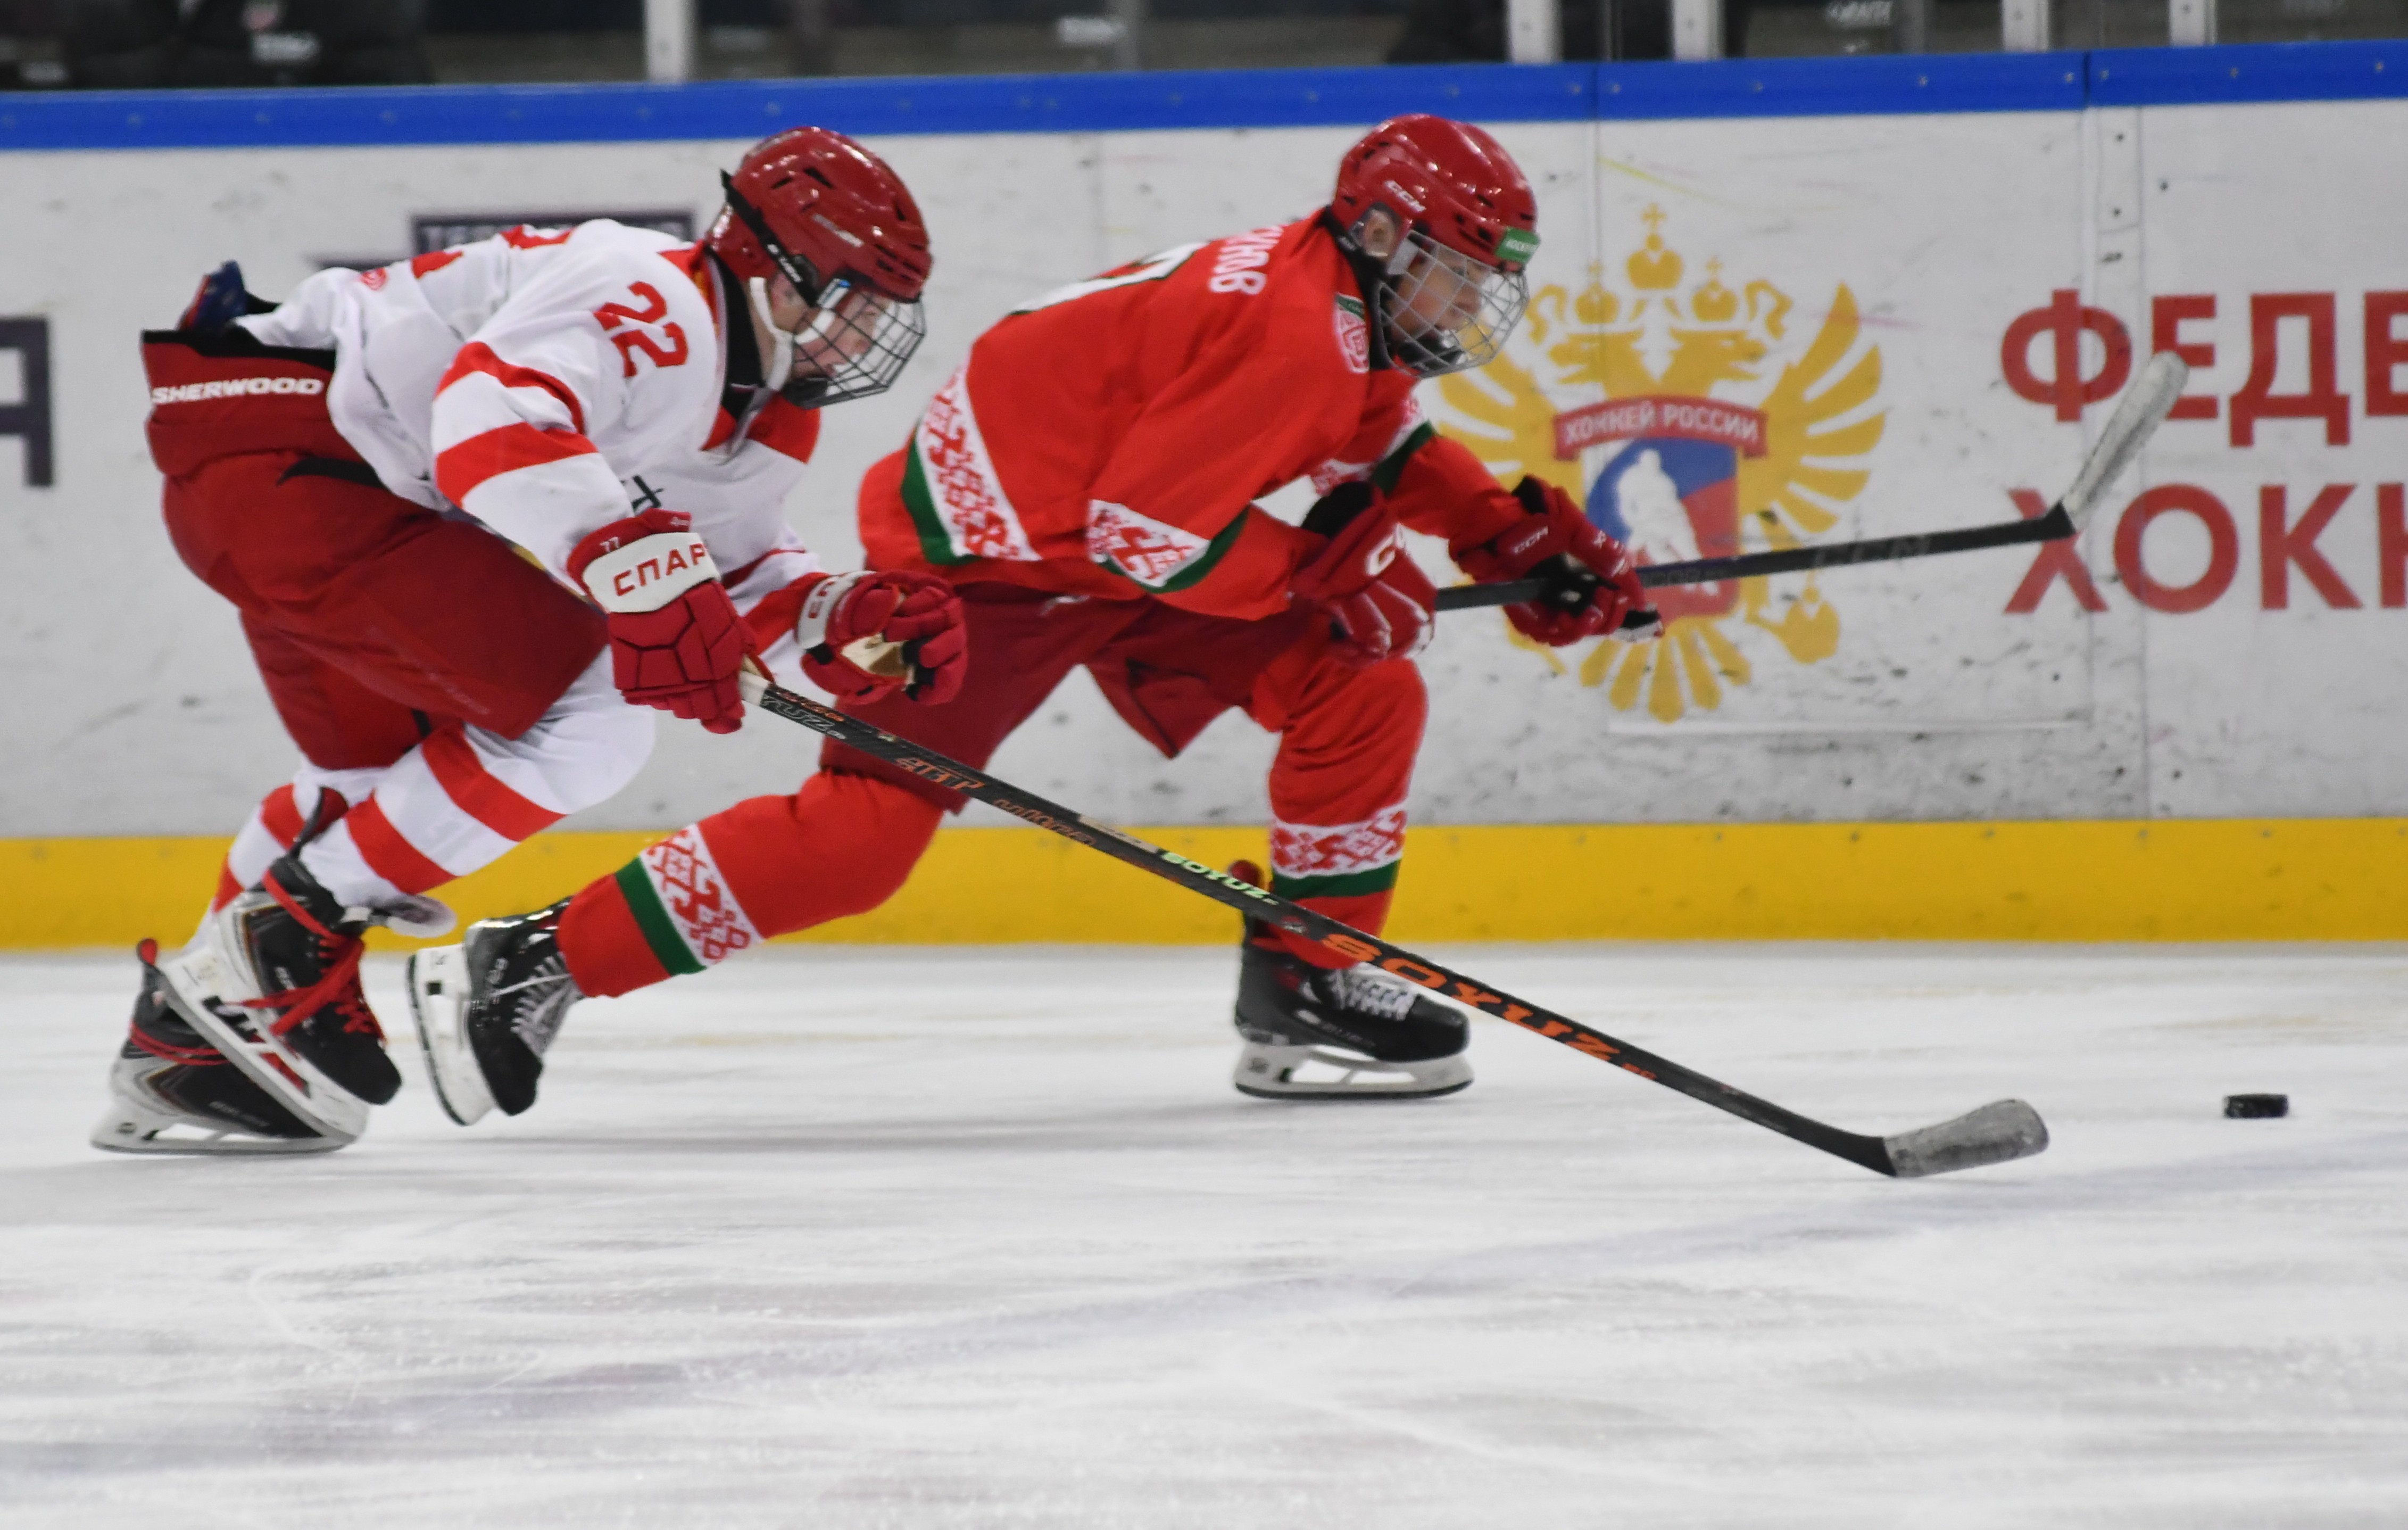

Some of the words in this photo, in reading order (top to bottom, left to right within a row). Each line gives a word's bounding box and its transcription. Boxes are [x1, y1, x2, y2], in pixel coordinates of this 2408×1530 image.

[593, 281, 687, 378] 22
[152, 377, 323, 405] SHERWOOD
[1662, 403, 1758, 443] РОССИИ
[1161, 851, 1271, 899] SOYUZ
[1322, 933, 1620, 1061] SOYUZ
